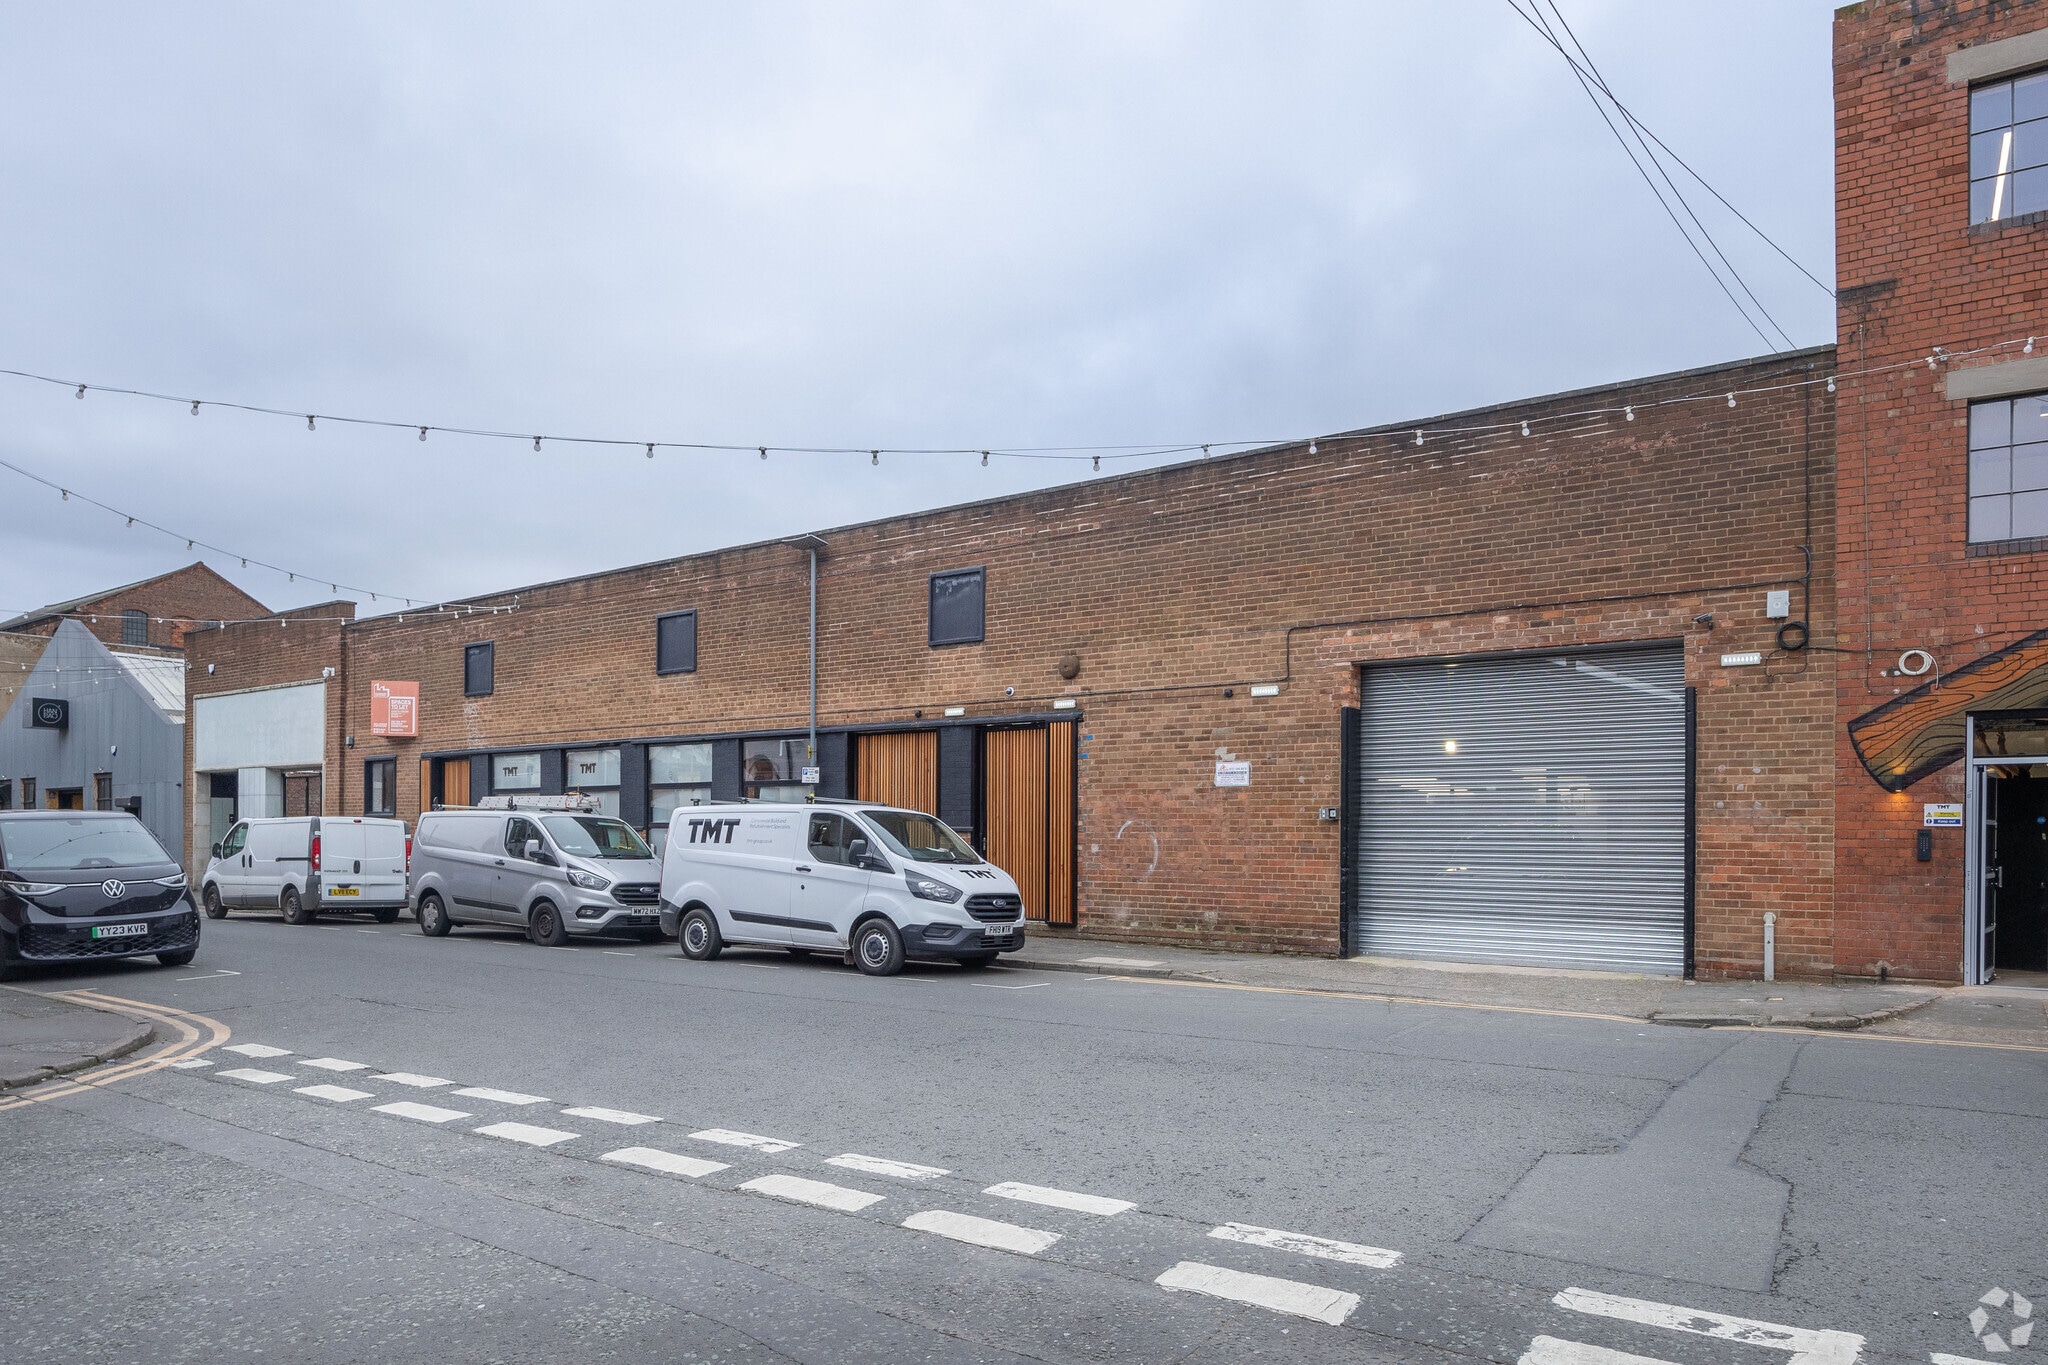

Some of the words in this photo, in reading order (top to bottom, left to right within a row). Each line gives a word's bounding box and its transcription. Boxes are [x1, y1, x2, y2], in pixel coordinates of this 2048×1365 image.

[503, 767, 518, 777] TMT
[580, 763, 596, 774] TMT
[688, 818, 741, 844] TMT
[959, 870, 997, 879] TMT
[100, 926, 125, 936] YY23
[127, 924, 146, 934] KVR
